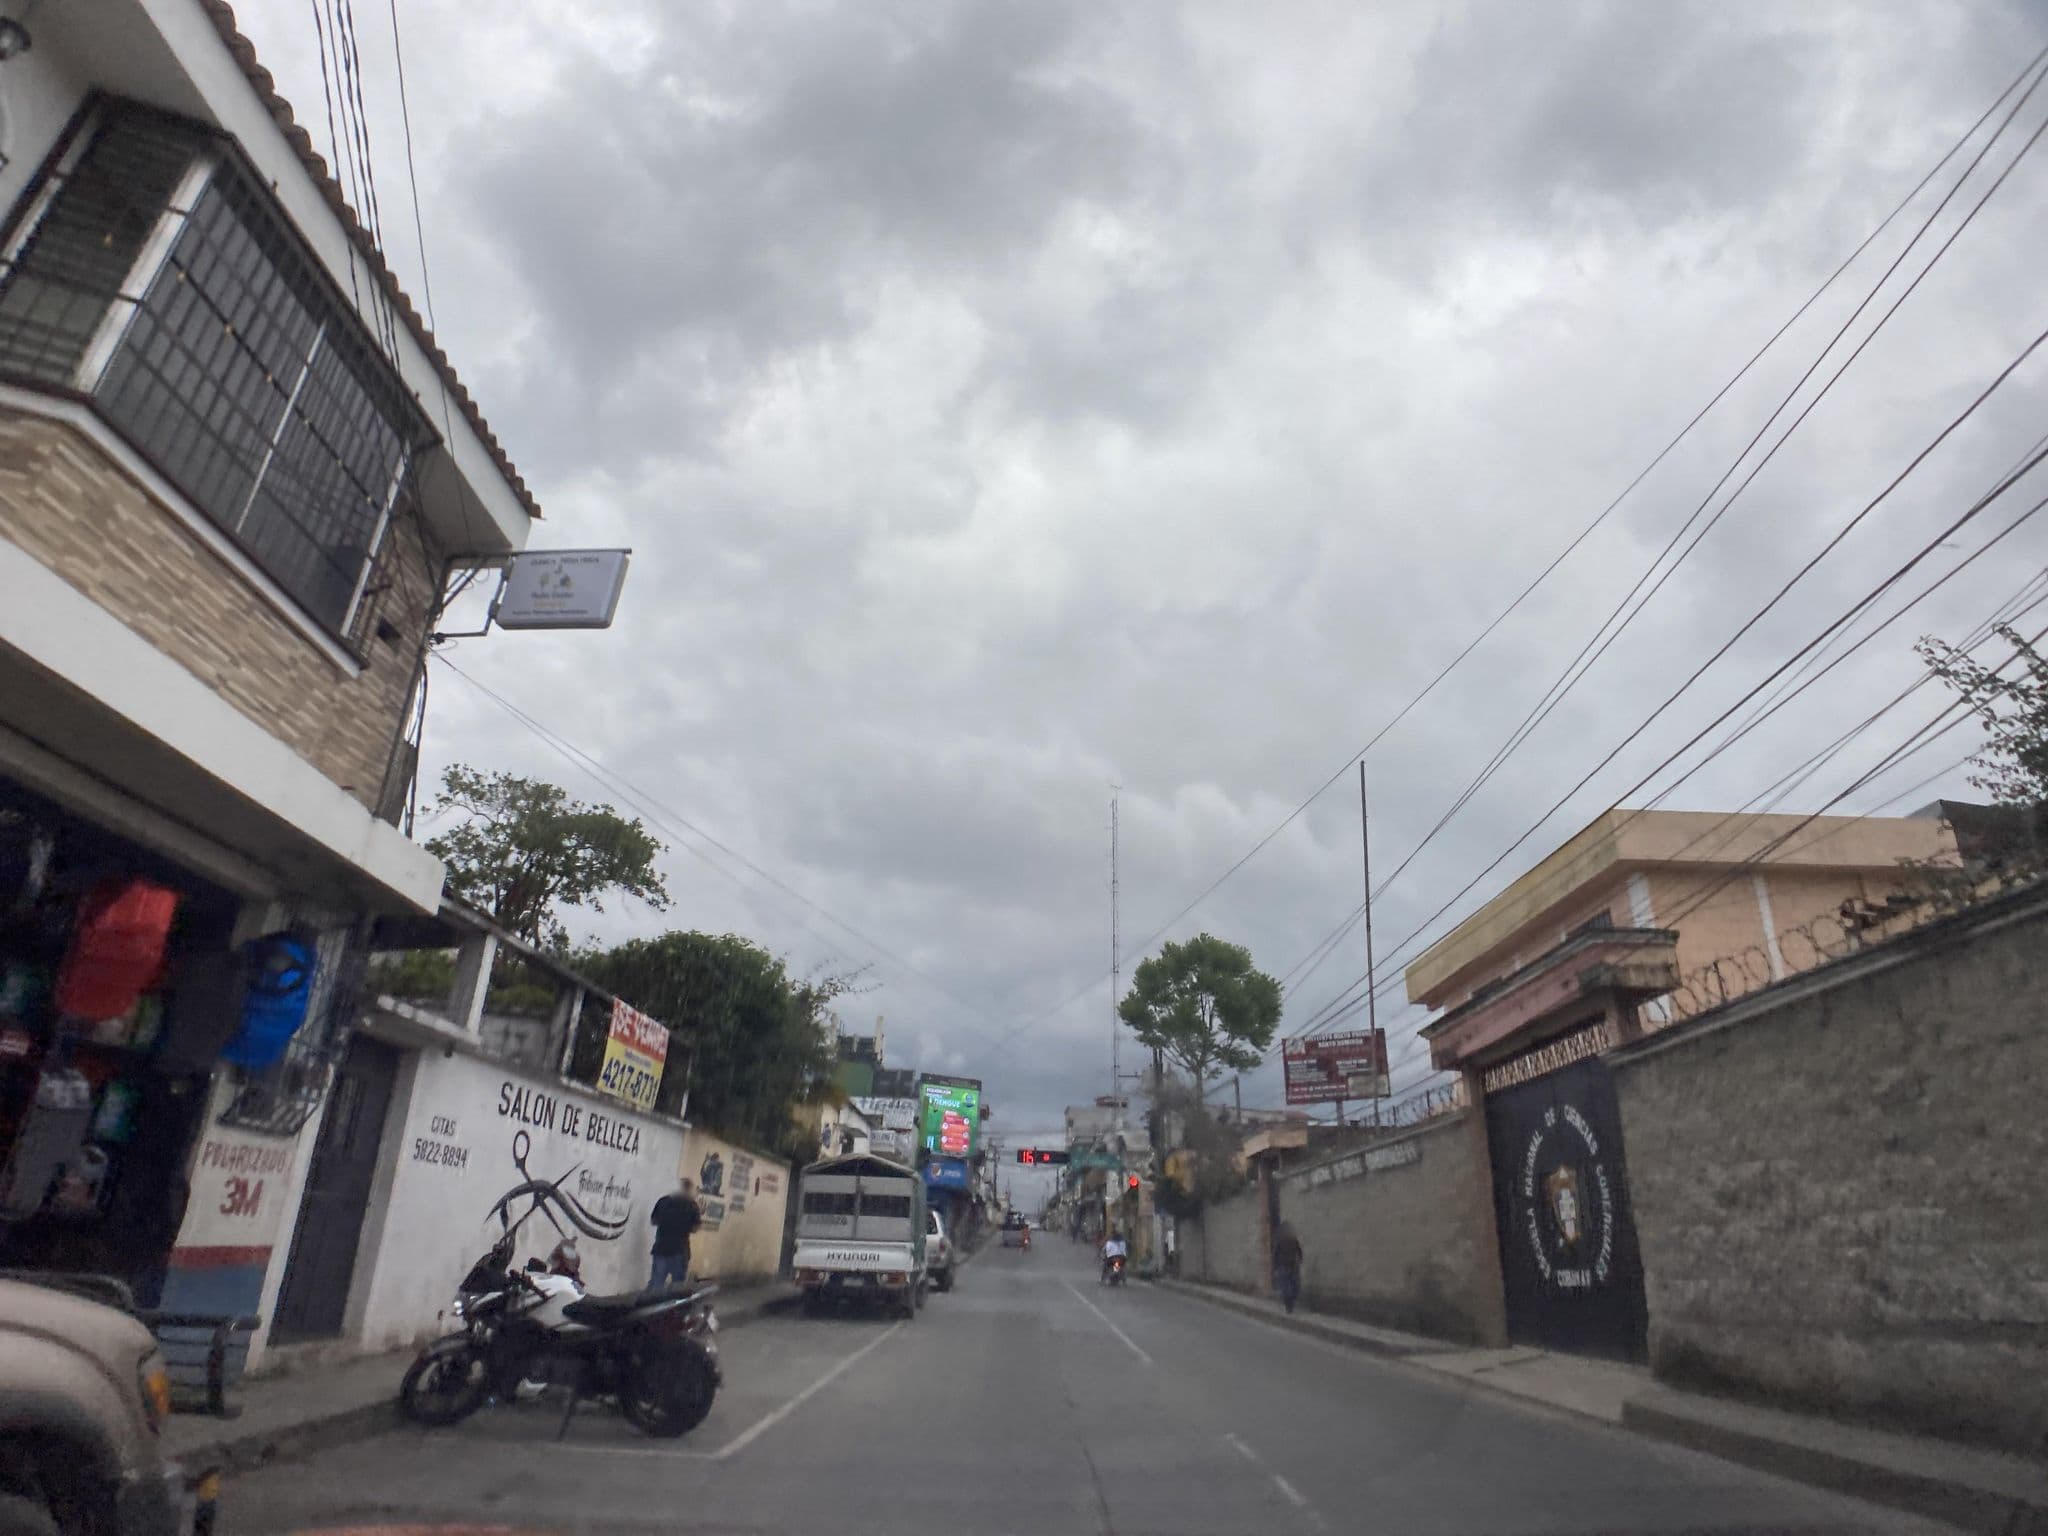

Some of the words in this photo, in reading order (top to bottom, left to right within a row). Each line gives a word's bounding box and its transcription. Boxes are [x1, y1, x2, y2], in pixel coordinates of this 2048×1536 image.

[431, 1116, 456, 1137] CITAS
[499, 1082, 557, 1129] SALON
[561, 1104, 582, 1137] DE
[585, 1113, 640, 1155] BELLEZA
[220, 1176, 263, 1216] 3M
[827, 1251, 880, 1261] HYUNDAI
